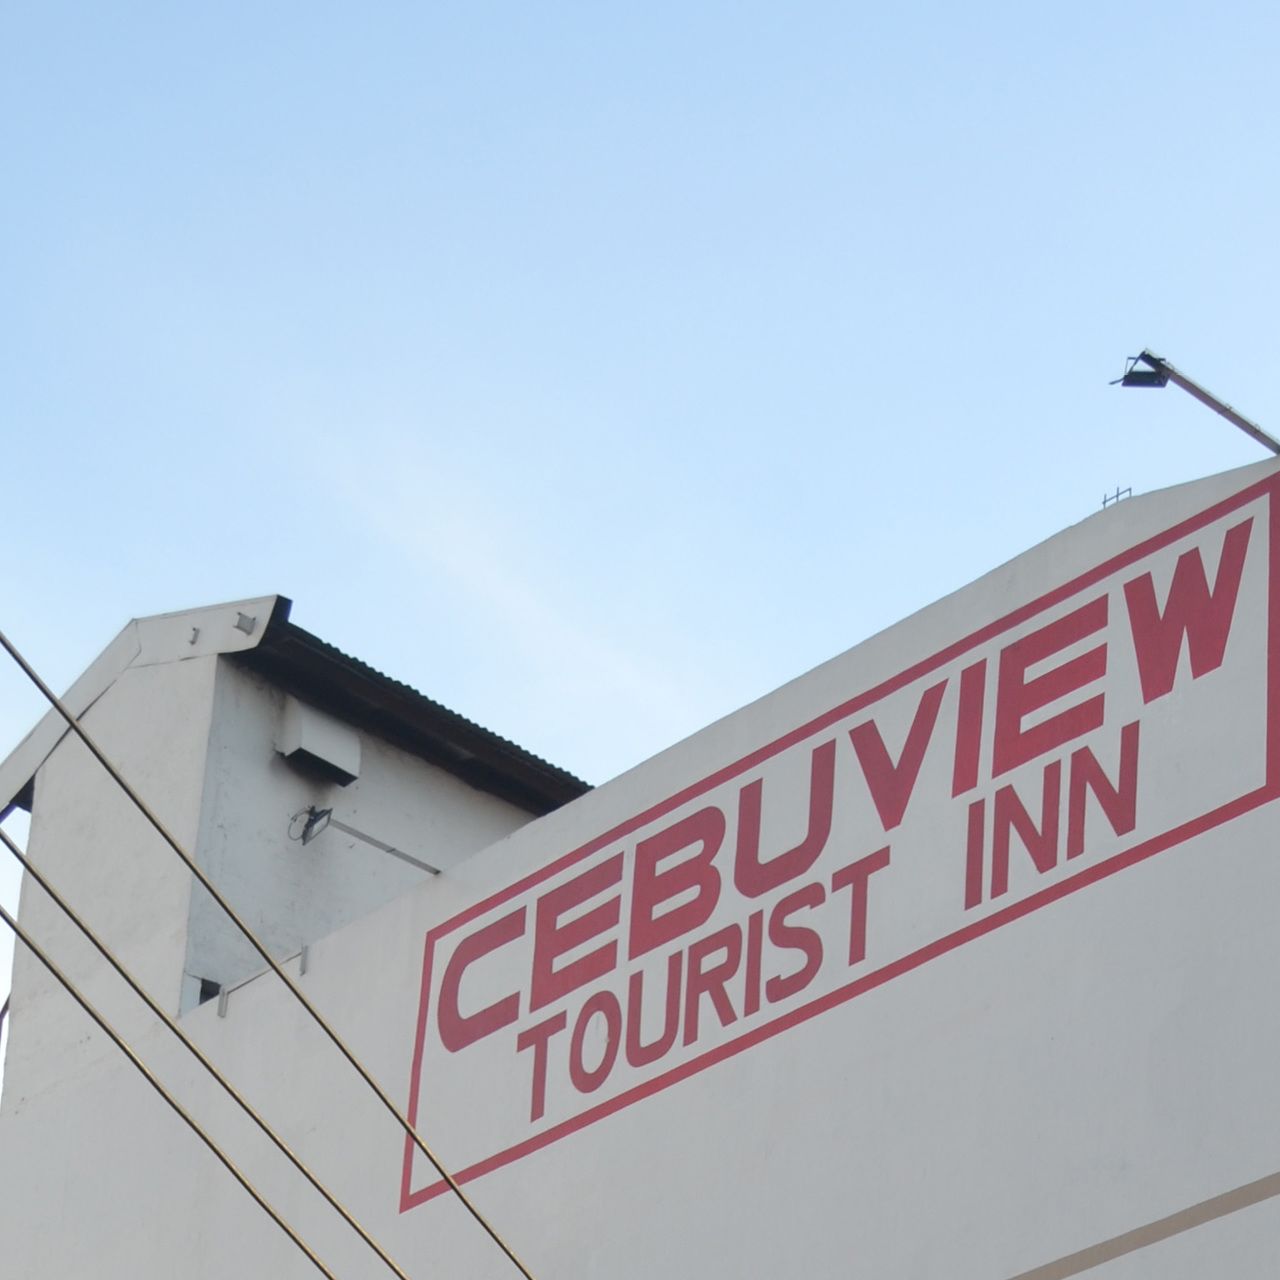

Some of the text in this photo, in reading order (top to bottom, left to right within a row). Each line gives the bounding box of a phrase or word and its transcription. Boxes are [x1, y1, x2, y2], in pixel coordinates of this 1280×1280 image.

[437, 516, 1254, 1054] CEBUVIEW
[516, 720, 1140, 1124] TOURIST INN
